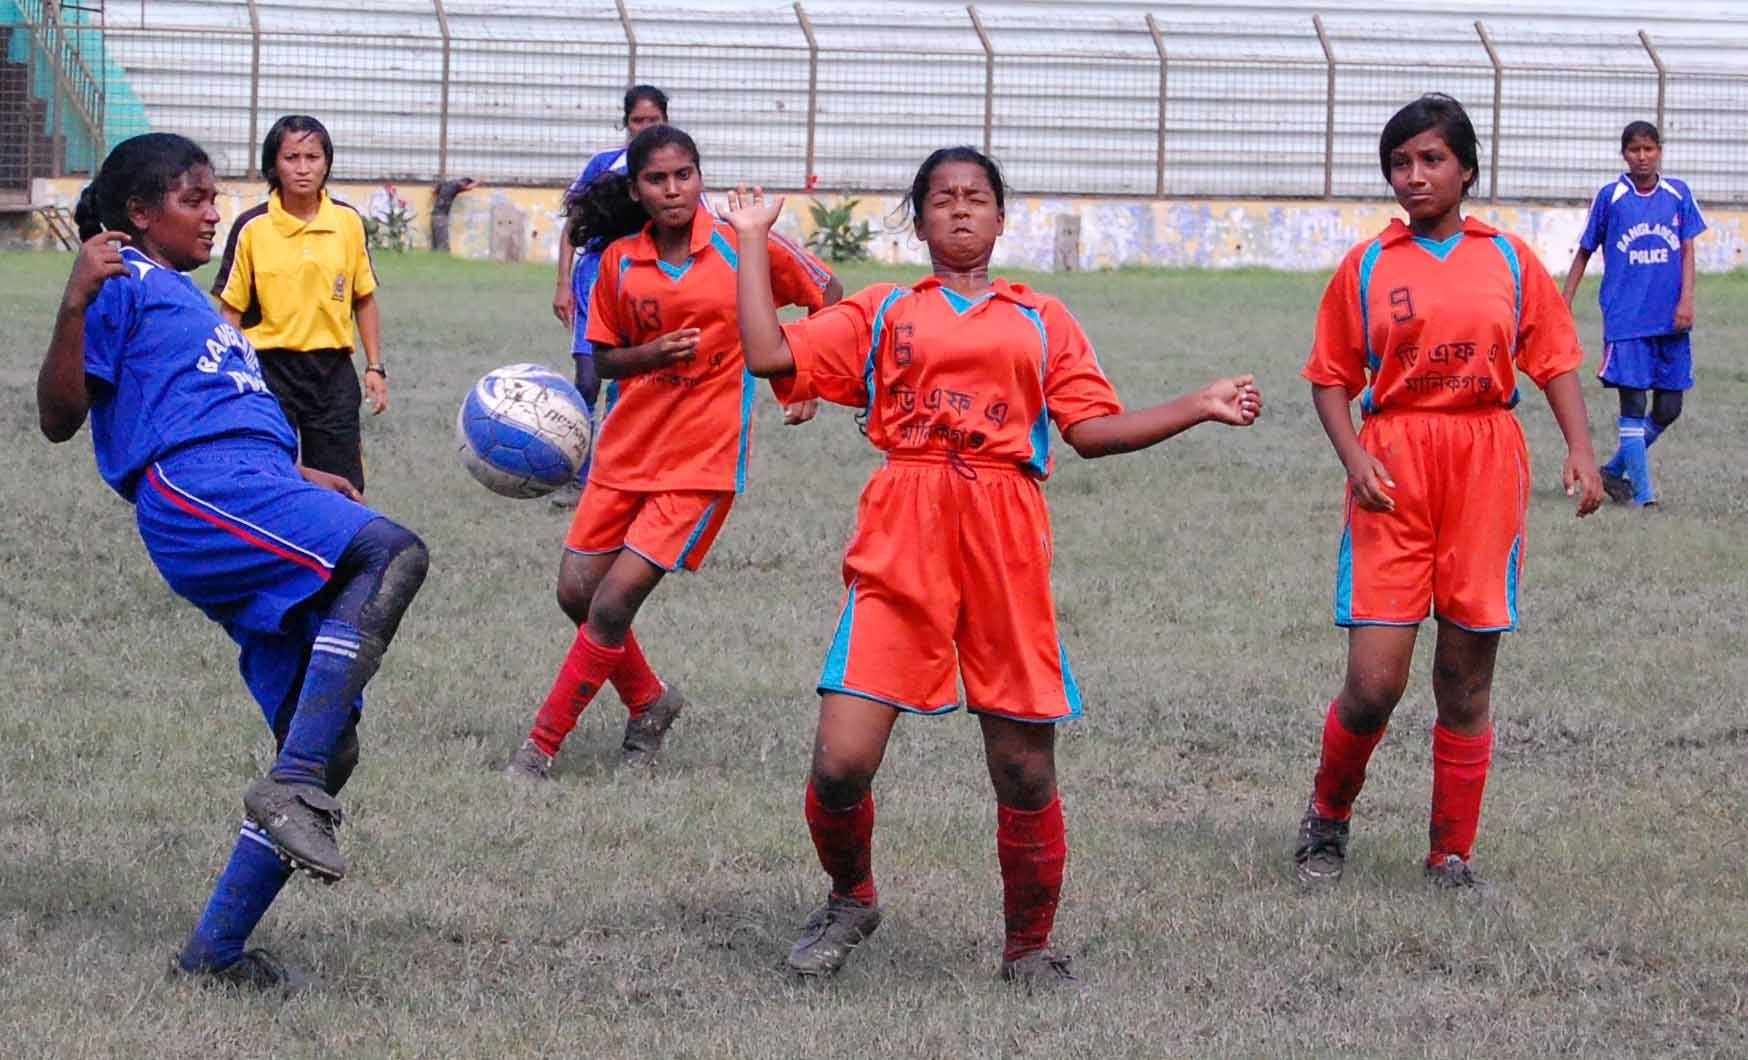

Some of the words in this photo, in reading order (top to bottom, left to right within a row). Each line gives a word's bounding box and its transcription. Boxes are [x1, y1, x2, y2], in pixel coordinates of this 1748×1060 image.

[1629, 248, 1668, 265] POLICE
[628, 298, 662, 331] 13
[1390, 287, 1414, 323] 9
[894, 324, 913, 368] 6
[890, 383, 917, 413] ডি
[984, 402, 1009, 429] এ
